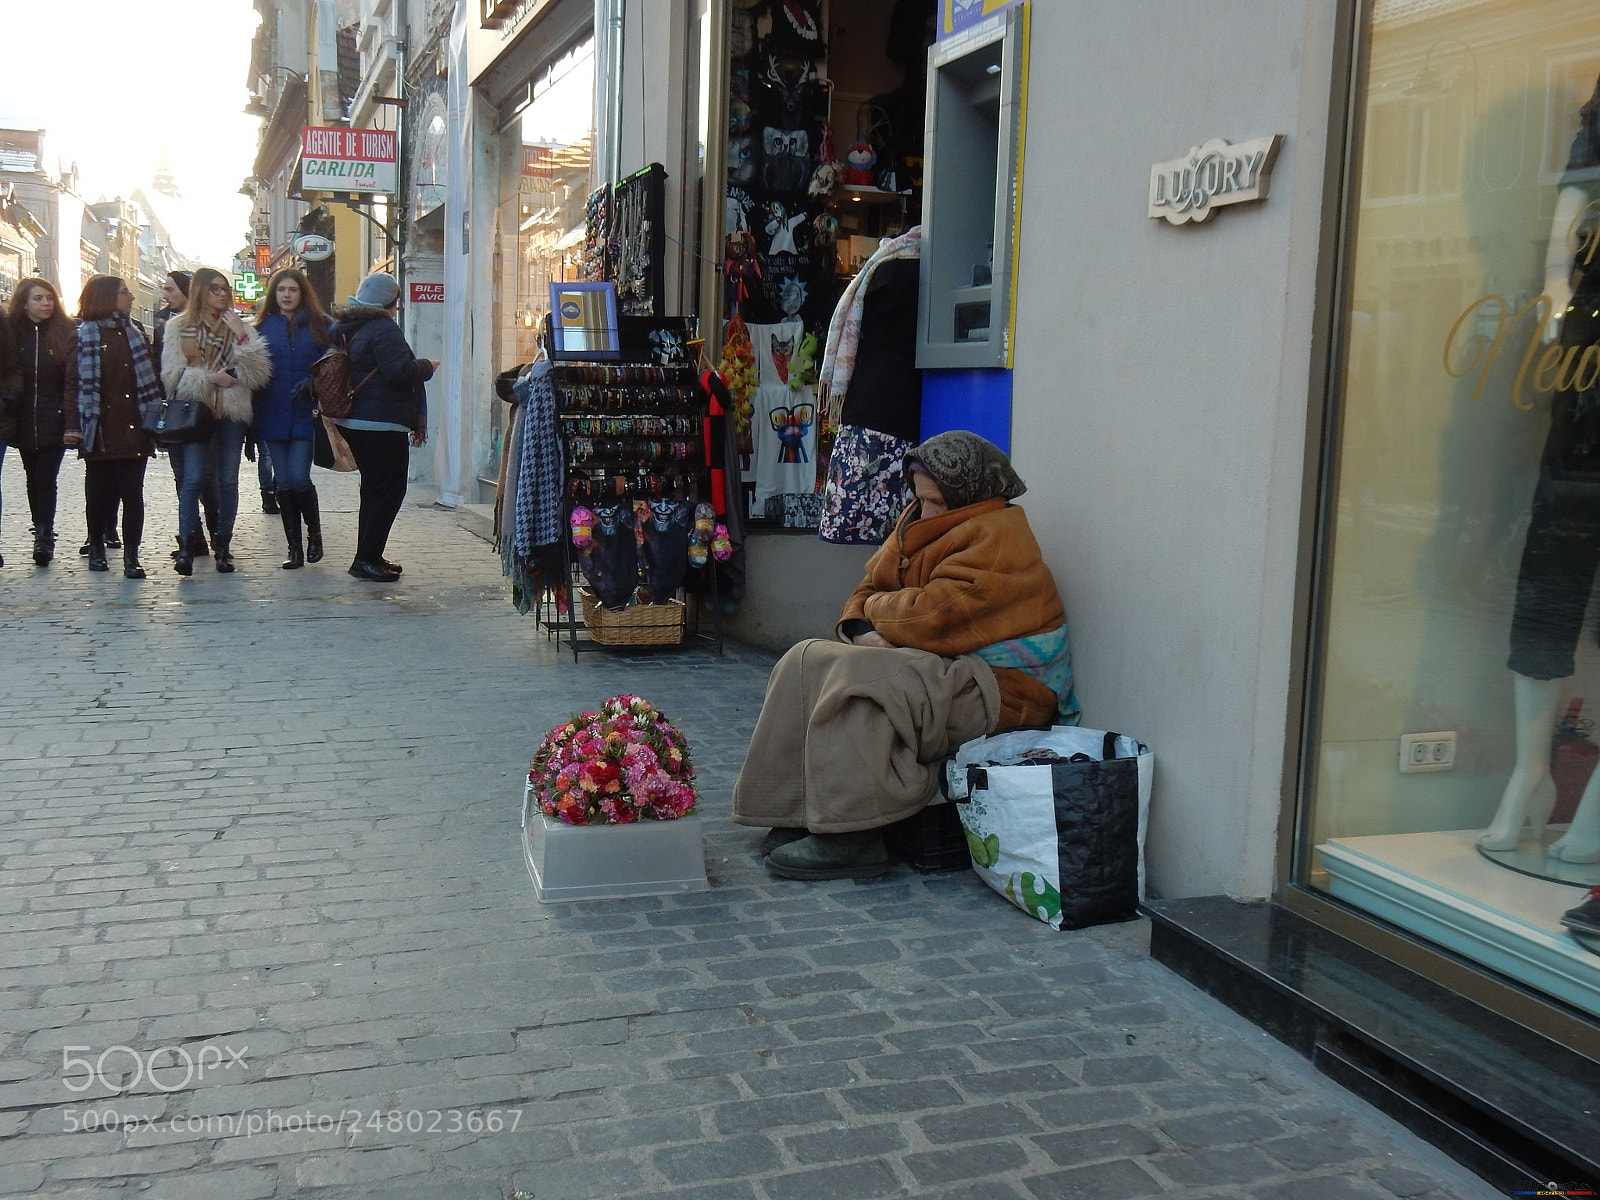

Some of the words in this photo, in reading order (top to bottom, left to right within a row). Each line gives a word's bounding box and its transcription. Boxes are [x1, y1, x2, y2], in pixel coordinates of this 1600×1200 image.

[305, 129, 342, 156] AGENTIE
[346, 132, 357, 157] DE
[361, 133, 394, 159] TURISM
[305, 159, 375, 178] CARLIDA
[1153, 151, 1263, 213] LUXURY
[415, 284, 444, 292] BILE
